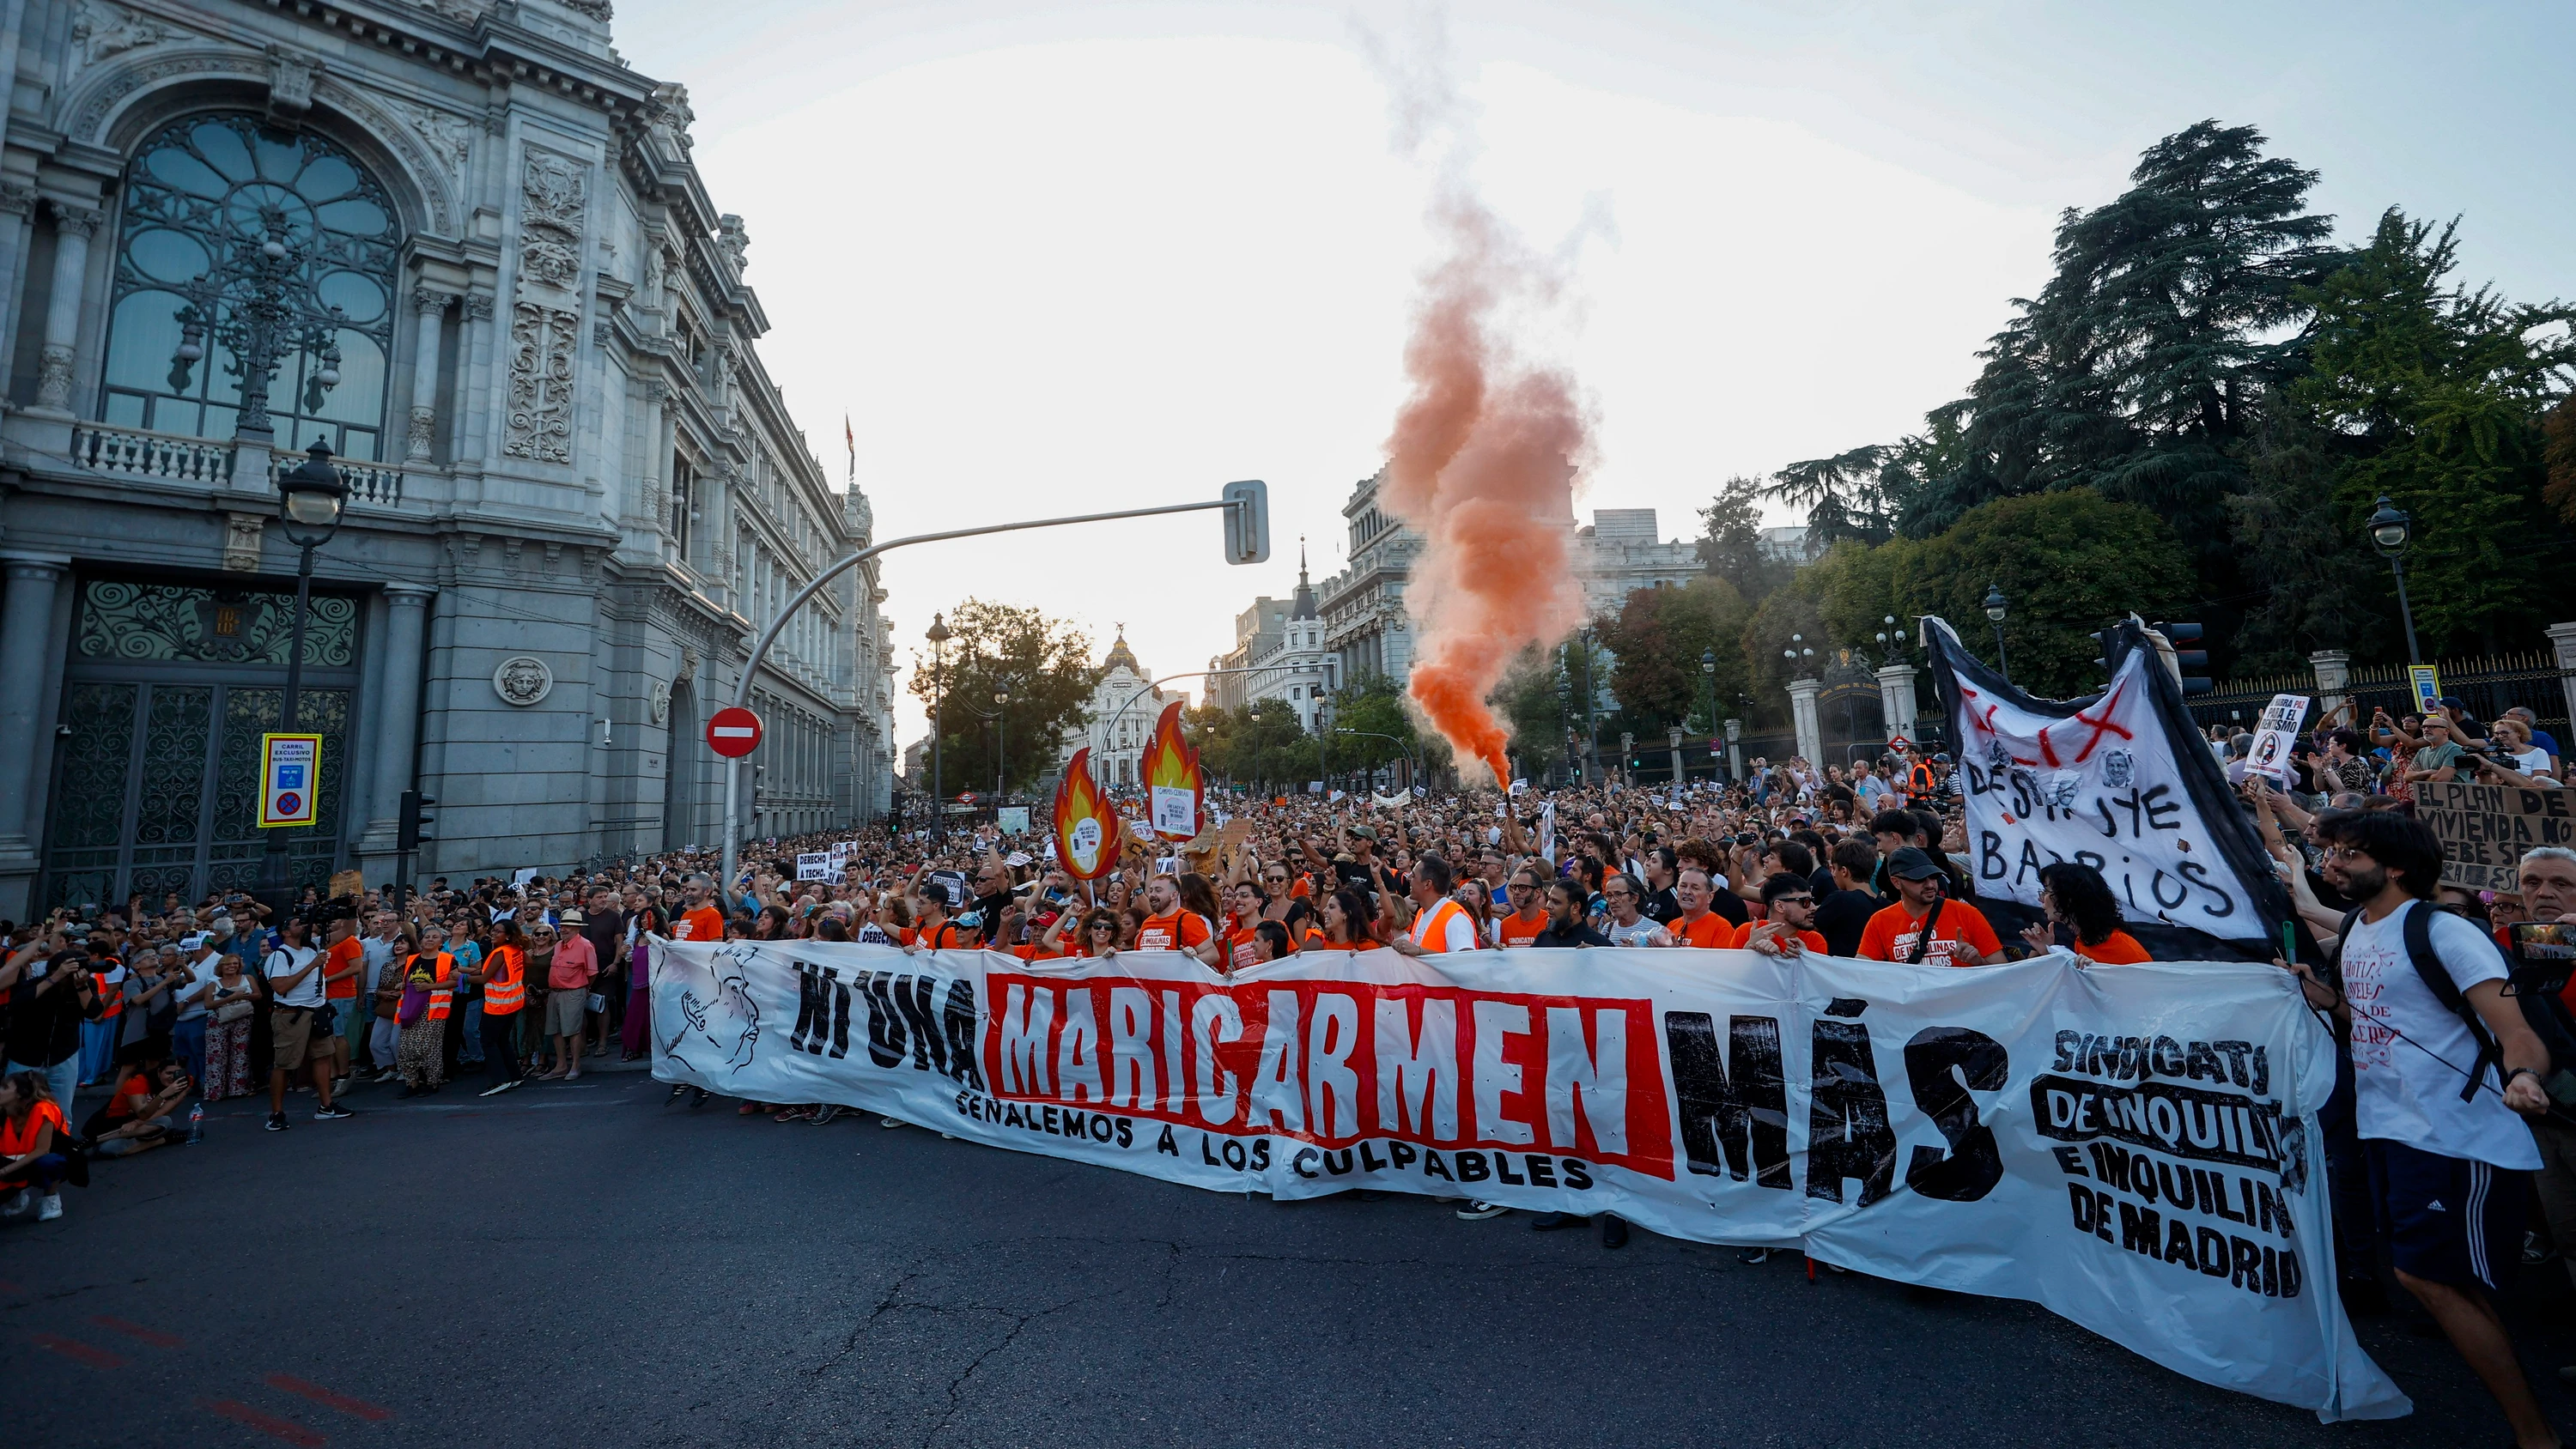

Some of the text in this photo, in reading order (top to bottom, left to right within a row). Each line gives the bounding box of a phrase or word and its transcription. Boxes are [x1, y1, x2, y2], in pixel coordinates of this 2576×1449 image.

[2293, 700, 2306, 709] PAZ
[2267, 707, 2297, 721] PARA EL
[2260, 718, 2298, 733] RENTISMO
[1512, 785, 1522, 794] NO
[2417, 783, 2570, 816] EL PLAN DE
[2542, 817, 2572, 844] NO
[799, 854, 827, 864] DERECHO
[2443, 840, 2553, 867] EBE SE
[805, 869, 826, 878] TECHO.
[835, 874, 846, 884] NO
[933, 876, 961, 888] DESAHUCIOS
[949, 890, 960, 901] ES!!!
[862, 929, 889, 943] DEREC
[1894, 930, 1937, 945] SINDICO
[1894, 942, 1956, 958] DE INILINAS
[1921, 955, 1952, 967] UILINOS
[2371, 1006, 2391, 1017] DE
[789, 961, 2008, 1208] NI UNA MARICARMEN MÁS
[2046, 1088, 2098, 1134] DE
[955, 1089, 1595, 1191] SEÑALEMOS A LOS CULPABLES
[2051, 1142, 2295, 1238] E INQUILIN
[2068, 1182, 2301, 1298] DE MADRID
